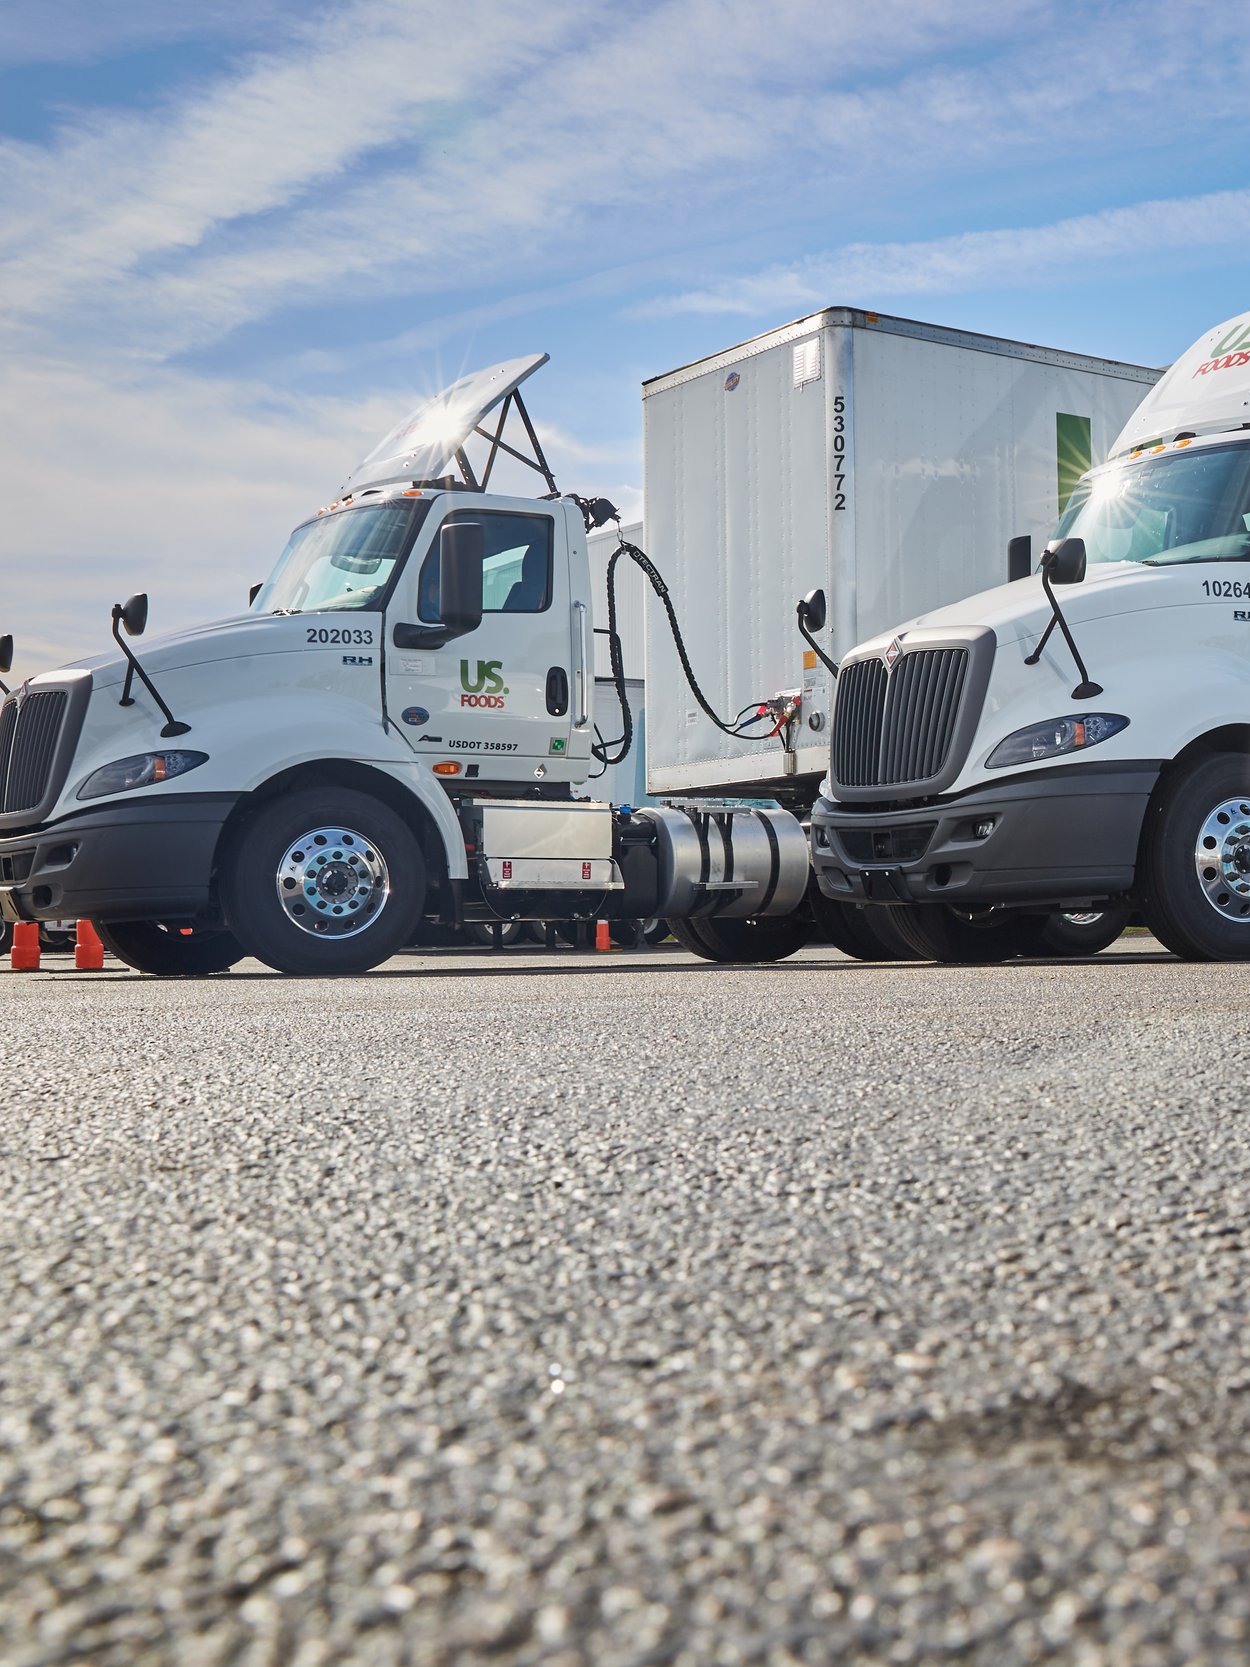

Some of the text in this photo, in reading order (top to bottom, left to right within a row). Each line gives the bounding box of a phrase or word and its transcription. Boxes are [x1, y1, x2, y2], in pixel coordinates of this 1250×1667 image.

[833, 396, 846, 511] 530772
[638, 555, 667, 593] TECTRAN
[306, 628, 373, 645] 202033
[342, 656, 373, 664] RH
[460, 694, 505, 708] FOODS
[448, 740, 518, 751] USDOT 358597
